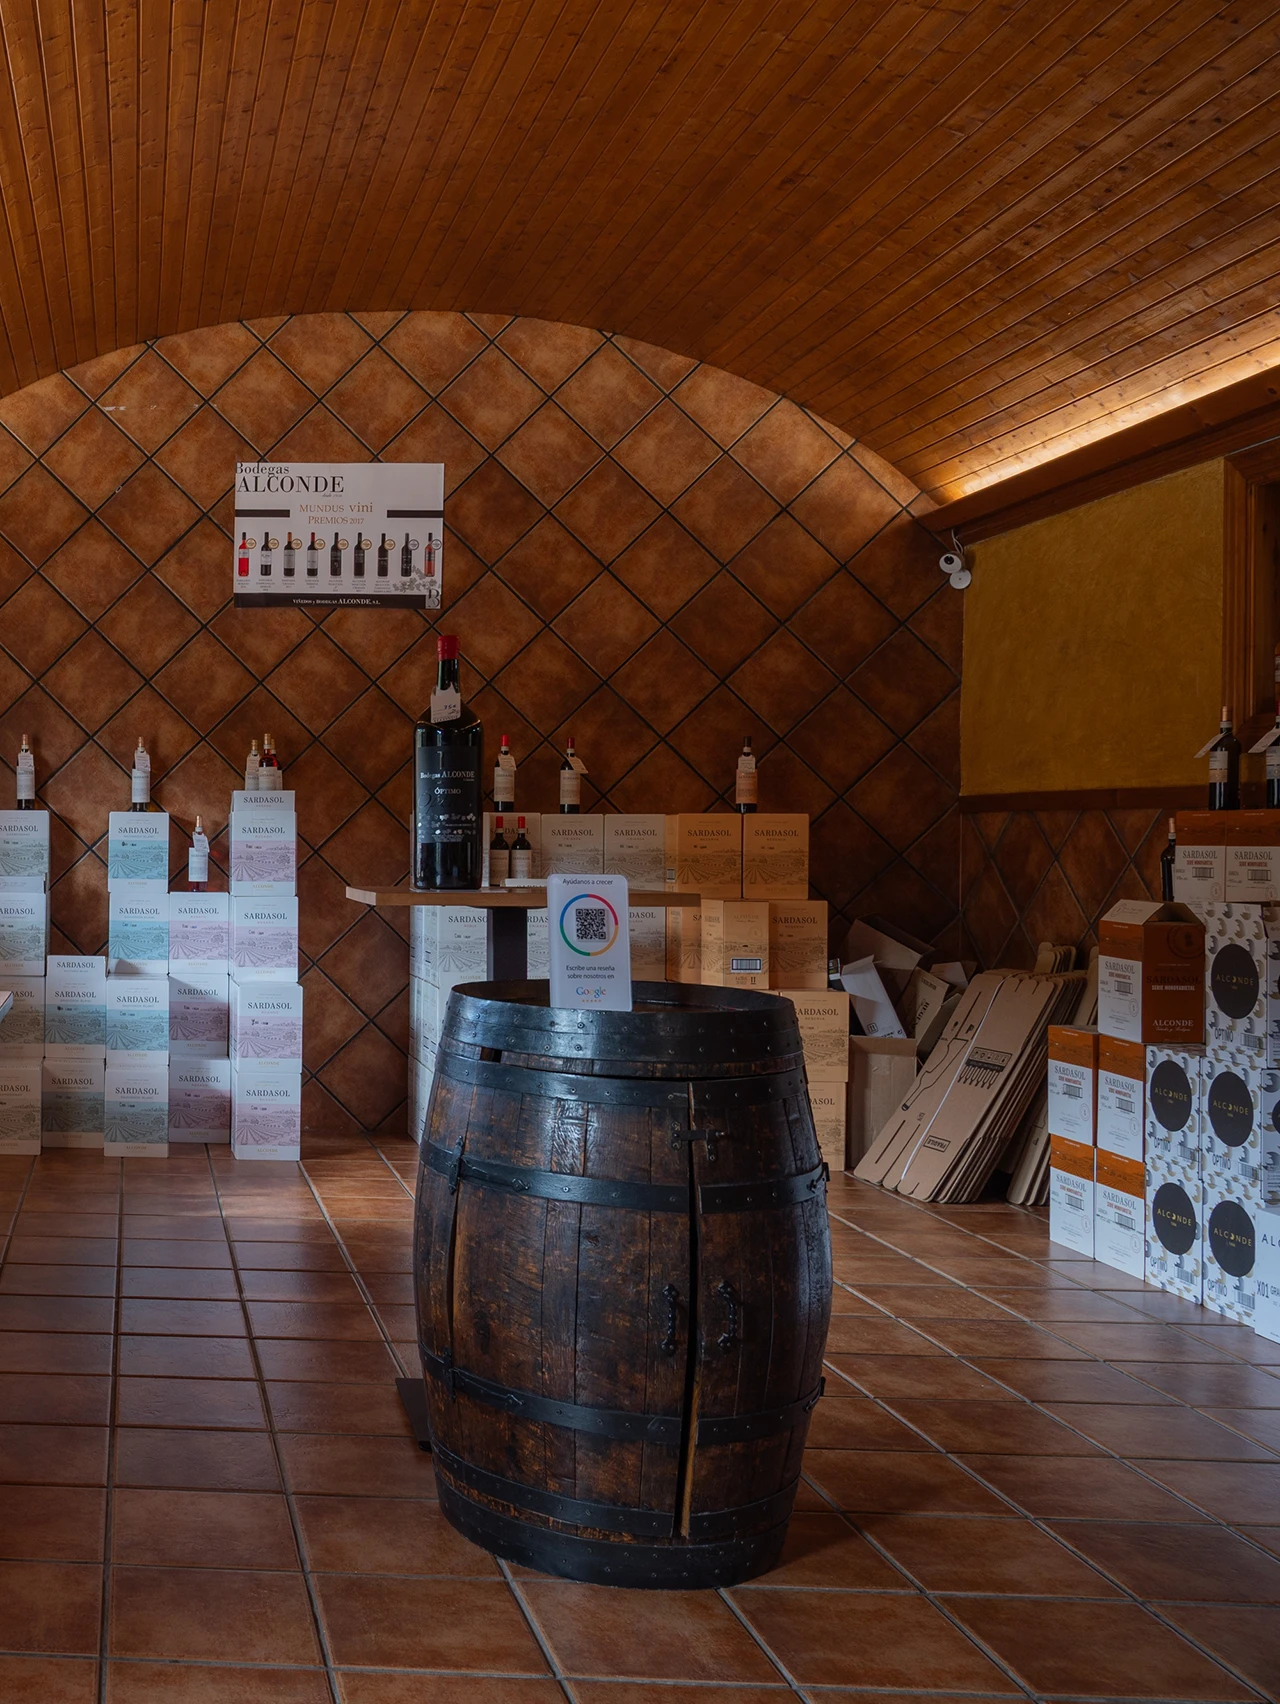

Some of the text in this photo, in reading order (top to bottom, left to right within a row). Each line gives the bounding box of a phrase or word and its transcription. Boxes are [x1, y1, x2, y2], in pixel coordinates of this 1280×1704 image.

[236, 462, 290, 478] Bodegas
[237, 475, 344, 493] ALCONDE
[299, 502, 373, 513] MUNDUS vini
[308, 515, 365, 525] PREMIOS 2017
[1182, 850, 1217, 859] SARDASOL
[1234, 851, 1273, 860] SARDASOL
[1105, 961, 1135, 974] SARDASOL
[1216, 974, 1254, 986] ALCONDE
[576, 986, 606, 998] Google
[1054, 1065, 1086, 1080] SARDASOL
[1105, 1076, 1136, 1093] SARDASOL
[1155, 1087, 1188, 1101] ALCONDE
[1213, 1100, 1249, 1115] ALCONDE
[1056, 1174, 1087, 1192] SARDASOL
[1103, 1191, 1136, 1210] SARDASOL
[1157, 1208, 1192, 1226] ALCONDE
[1214, 1228, 1252, 1247] ALCONDE
